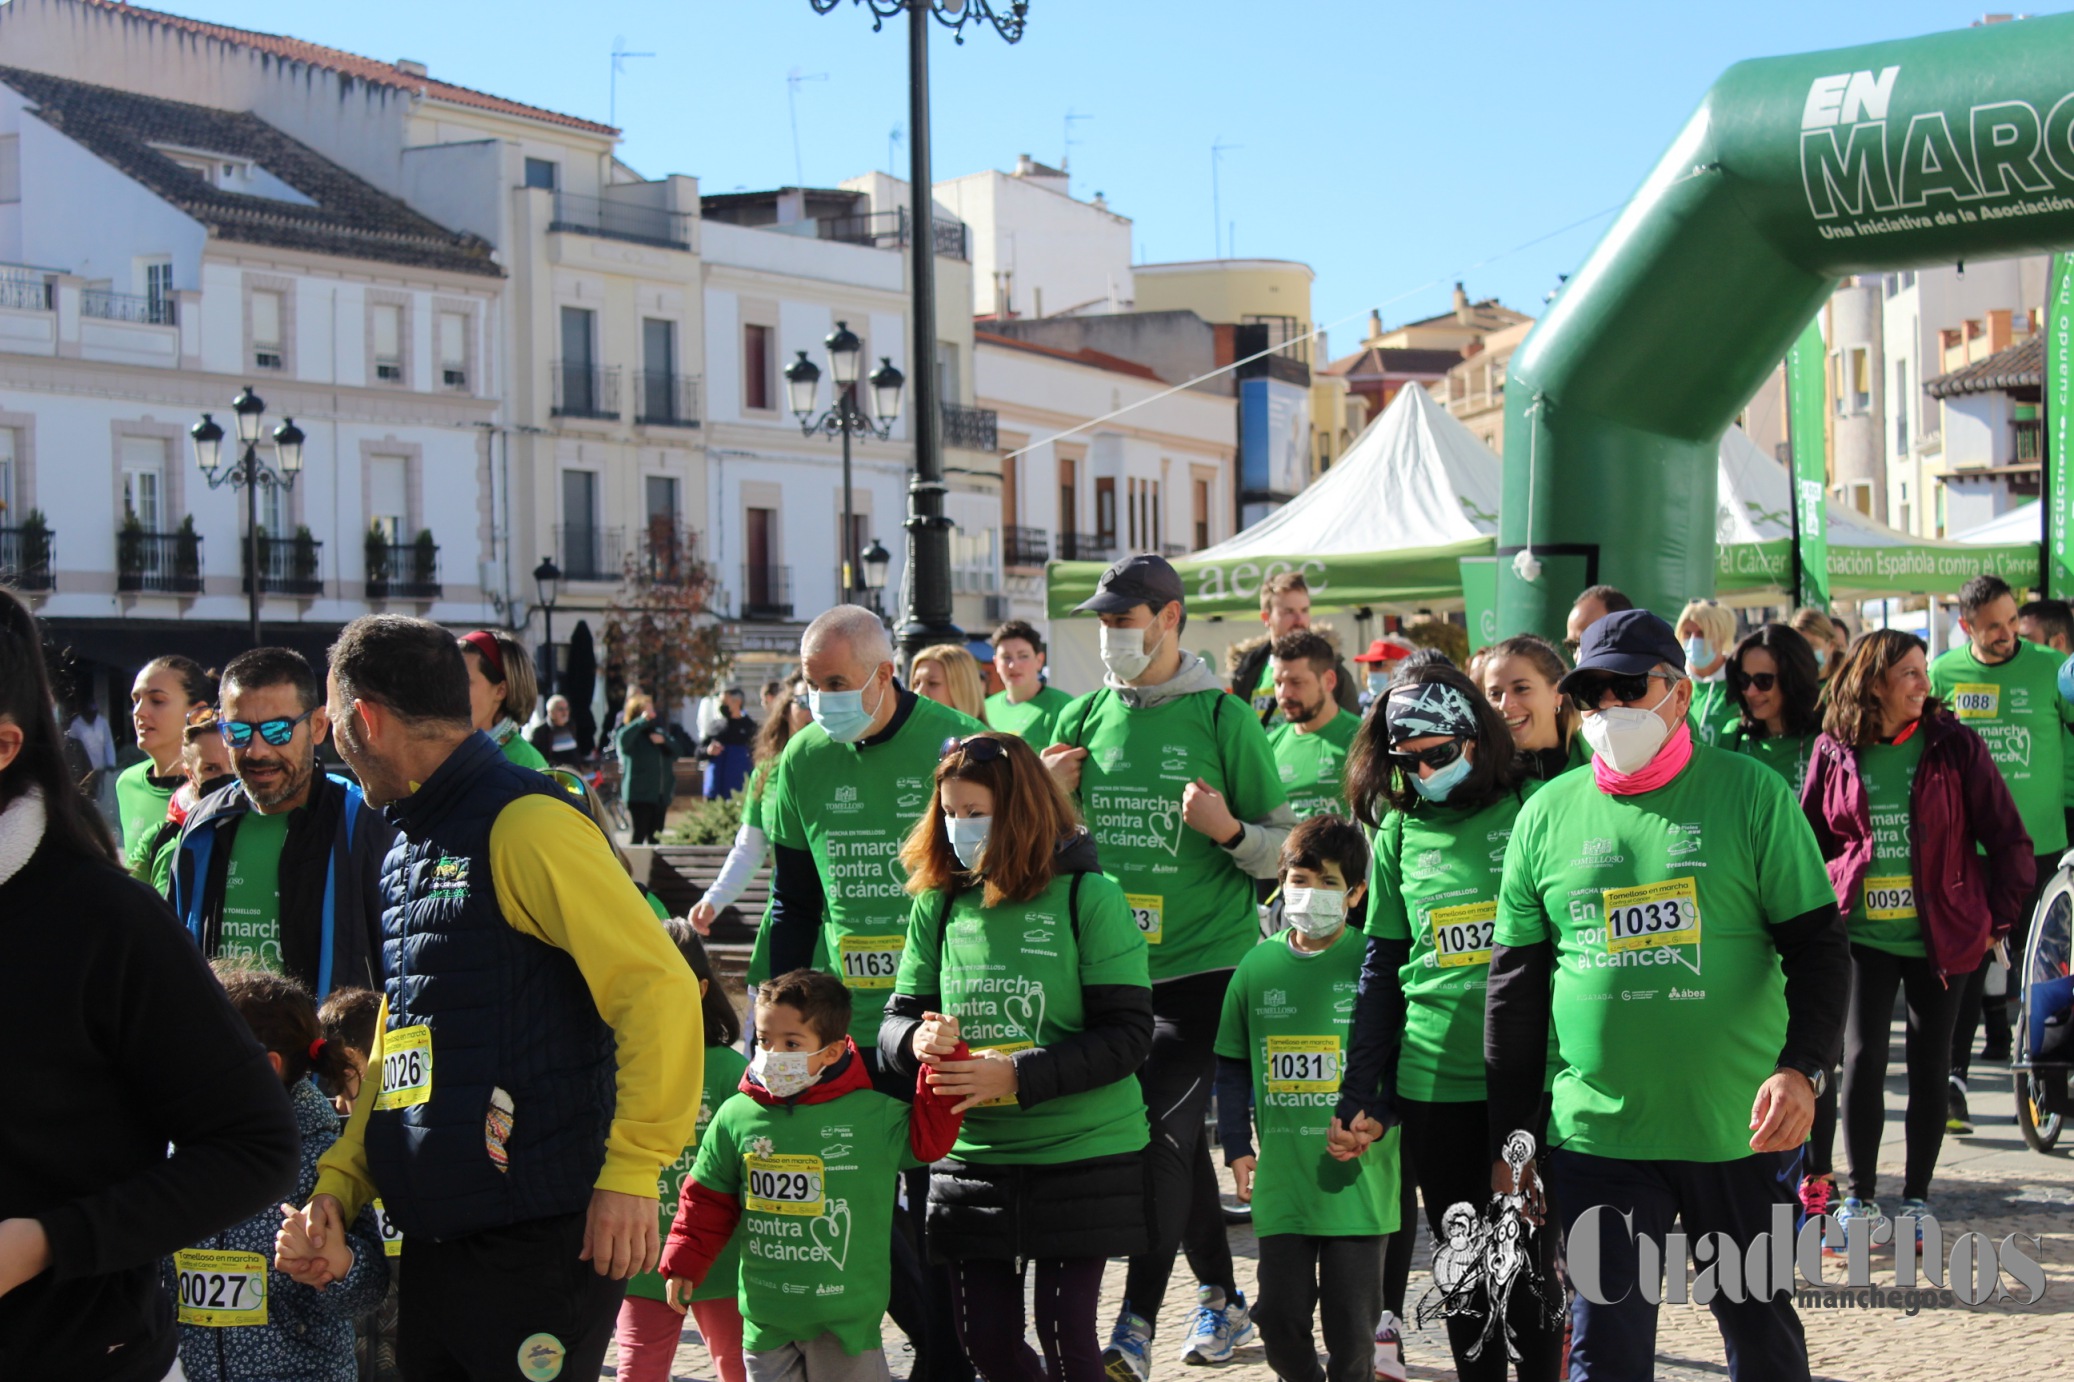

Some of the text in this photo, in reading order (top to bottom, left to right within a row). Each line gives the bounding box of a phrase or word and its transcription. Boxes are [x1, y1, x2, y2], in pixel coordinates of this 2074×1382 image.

[1801, 65, 1901, 130] EN
[1818, 196, 2074, 240] Una iniciativa de la Asociación
[1876, 550, 1935, 582] Española
[1938, 555, 1980, 576] contra
[1957, 694, 1990, 711] 1088
[1092, 793, 1180, 812] En marcha
[826, 839, 846, 857] En
[1095, 829, 1167, 848] el cáncer
[828, 860, 882, 877] contra
[829, 882, 843, 898] el
[1608, 891, 1648, 900] Tomelloso
[1659, 882, 1689, 892] marcha
[1866, 889, 1912, 909] 0092
[228, 907, 261, 915] TOMELLOSO
[1568, 900, 1595, 922] En
[1609, 901, 1681, 936] 1033
[1438, 922, 1495, 953] 1032
[844, 952, 895, 976] 1163
[1578, 949, 1591, 969] el
[943, 974, 1043, 995] En marcha
[961, 1020, 1027, 1040] cáncer
[383, 1051, 420, 1092] 0026
[1270, 1054, 1322, 1079] 1031
[791, 1157, 818, 1165] marcha
[750, 1170, 808, 1200] 0029
[747, 1217, 802, 1237] contra
[179, 1252, 215, 1262] Tomelloso
[749, 1237, 833, 1262] el cáncer
[180, 1271, 247, 1307] 0027
